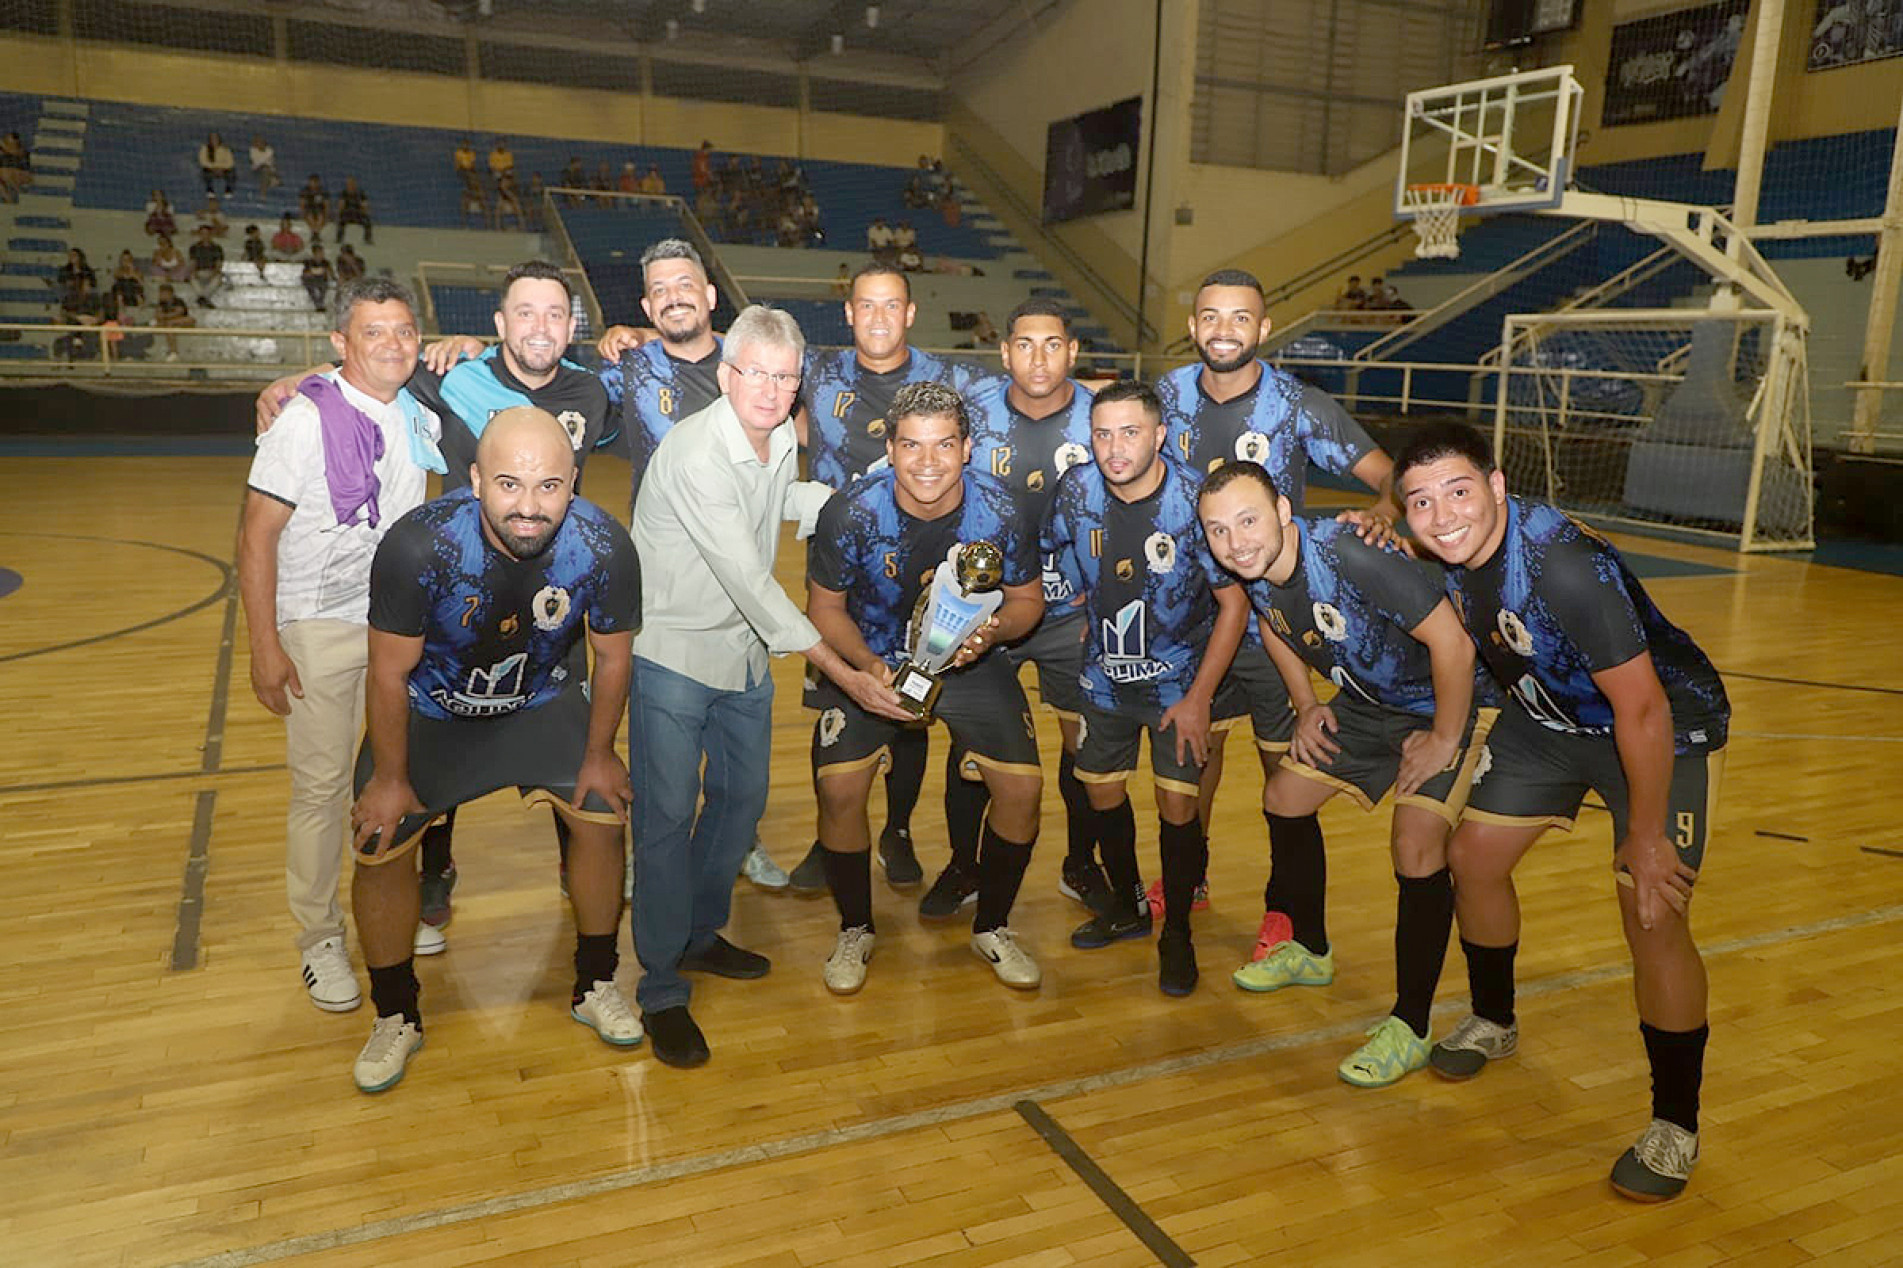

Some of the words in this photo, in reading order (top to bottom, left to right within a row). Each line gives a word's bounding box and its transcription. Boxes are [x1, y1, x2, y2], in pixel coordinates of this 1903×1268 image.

[658, 387, 673, 415] 8
[833, 391, 857, 418] 17
[1179, 429, 1190, 461] 4
[990, 446, 1012, 477] 12
[1090, 529, 1104, 558] 11
[884, 551, 899, 579] 5
[461, 595, 480, 627] 7
[1676, 811, 1695, 849] 9
